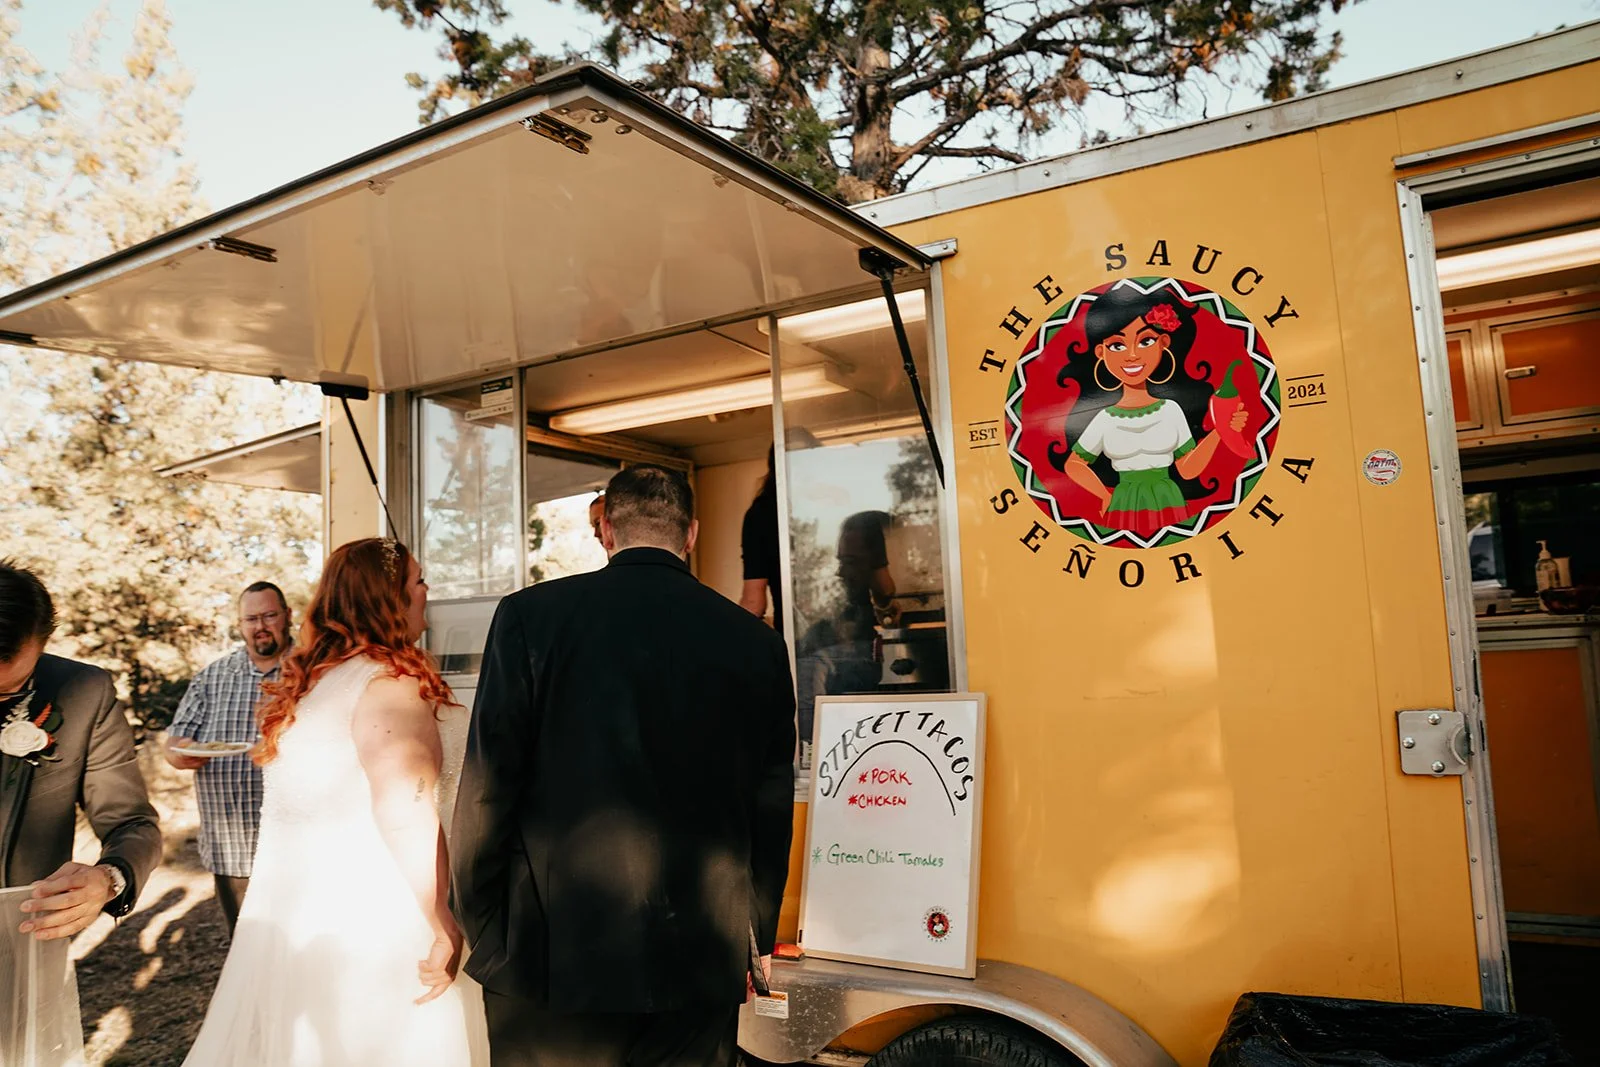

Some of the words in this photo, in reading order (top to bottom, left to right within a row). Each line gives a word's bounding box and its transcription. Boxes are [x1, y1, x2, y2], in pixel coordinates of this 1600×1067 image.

[978, 275, 1063, 375] THE
[1104, 240, 1299, 330] SAUCY
[1287, 382, 1326, 399] 2021
[969, 428, 997, 442] EST
[989, 454, 1314, 588] SEÑORITA
[819, 710, 910, 797] STREET
[917, 712, 974, 801] TACOS
[871, 768, 912, 785] PORK
[827, 843, 864, 865] Green
[867, 849, 895, 864] Chili
[898, 853, 944, 867] Tamales
